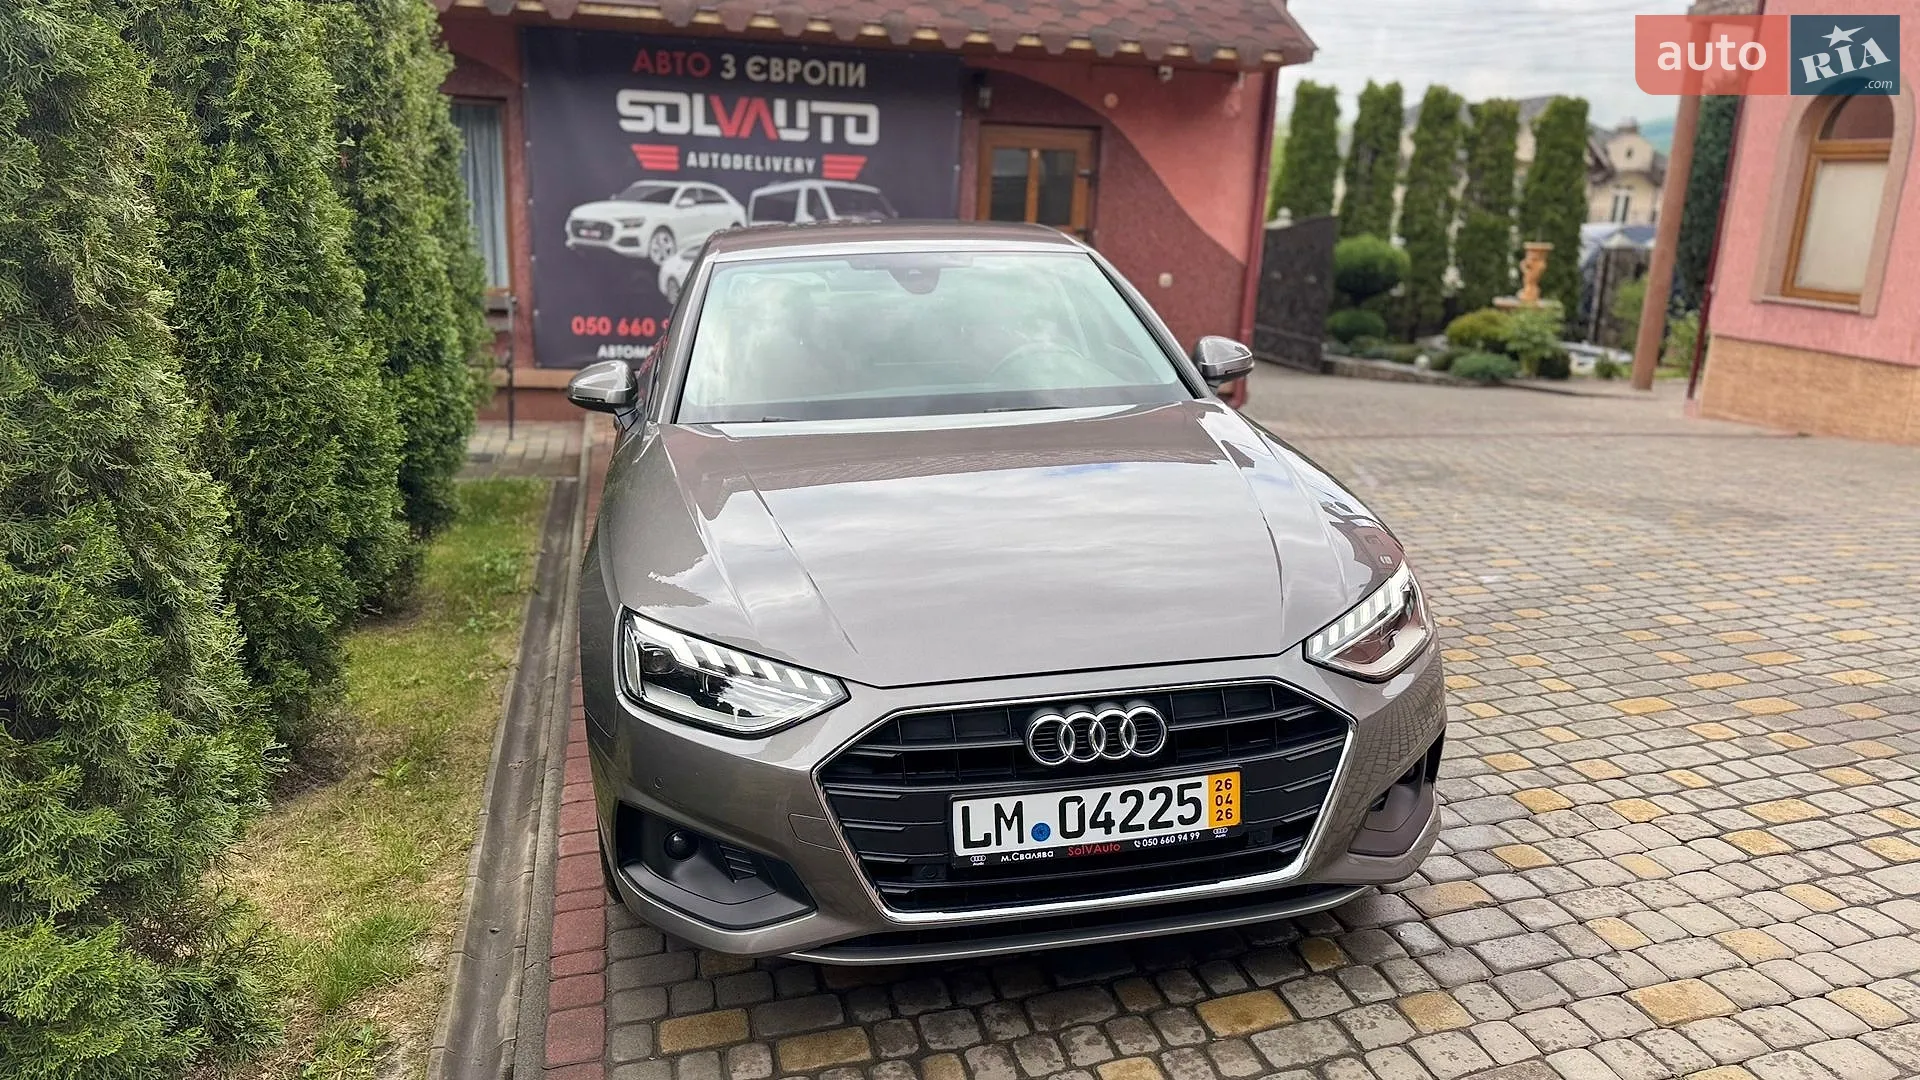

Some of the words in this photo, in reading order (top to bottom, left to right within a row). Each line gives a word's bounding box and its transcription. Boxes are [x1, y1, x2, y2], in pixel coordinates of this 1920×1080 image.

[632, 49, 712, 77] АВТО
[745, 56, 866, 87] ЄВРОПИ
[616, 89, 879, 145] SOLVAUTO
[687, 152, 816, 174] AUTODELIVERY
[571, 316, 612, 336] 050
[617, 318, 656, 337] 660
[1215, 778, 1232, 792] 26
[1215, 793, 1233, 806] 04
[962, 801, 1024, 849] LM
[1058, 782, 1202, 839] 04225
[1216, 808, 1233, 821] 26
[1142, 838, 1158, 847] 050
[1160, 836, 1176, 845] 660
[1178, 834, 1188, 842] 94
[1190, 831, 1200, 840] 99
[1068, 842, 1121, 857] SolVAuto
